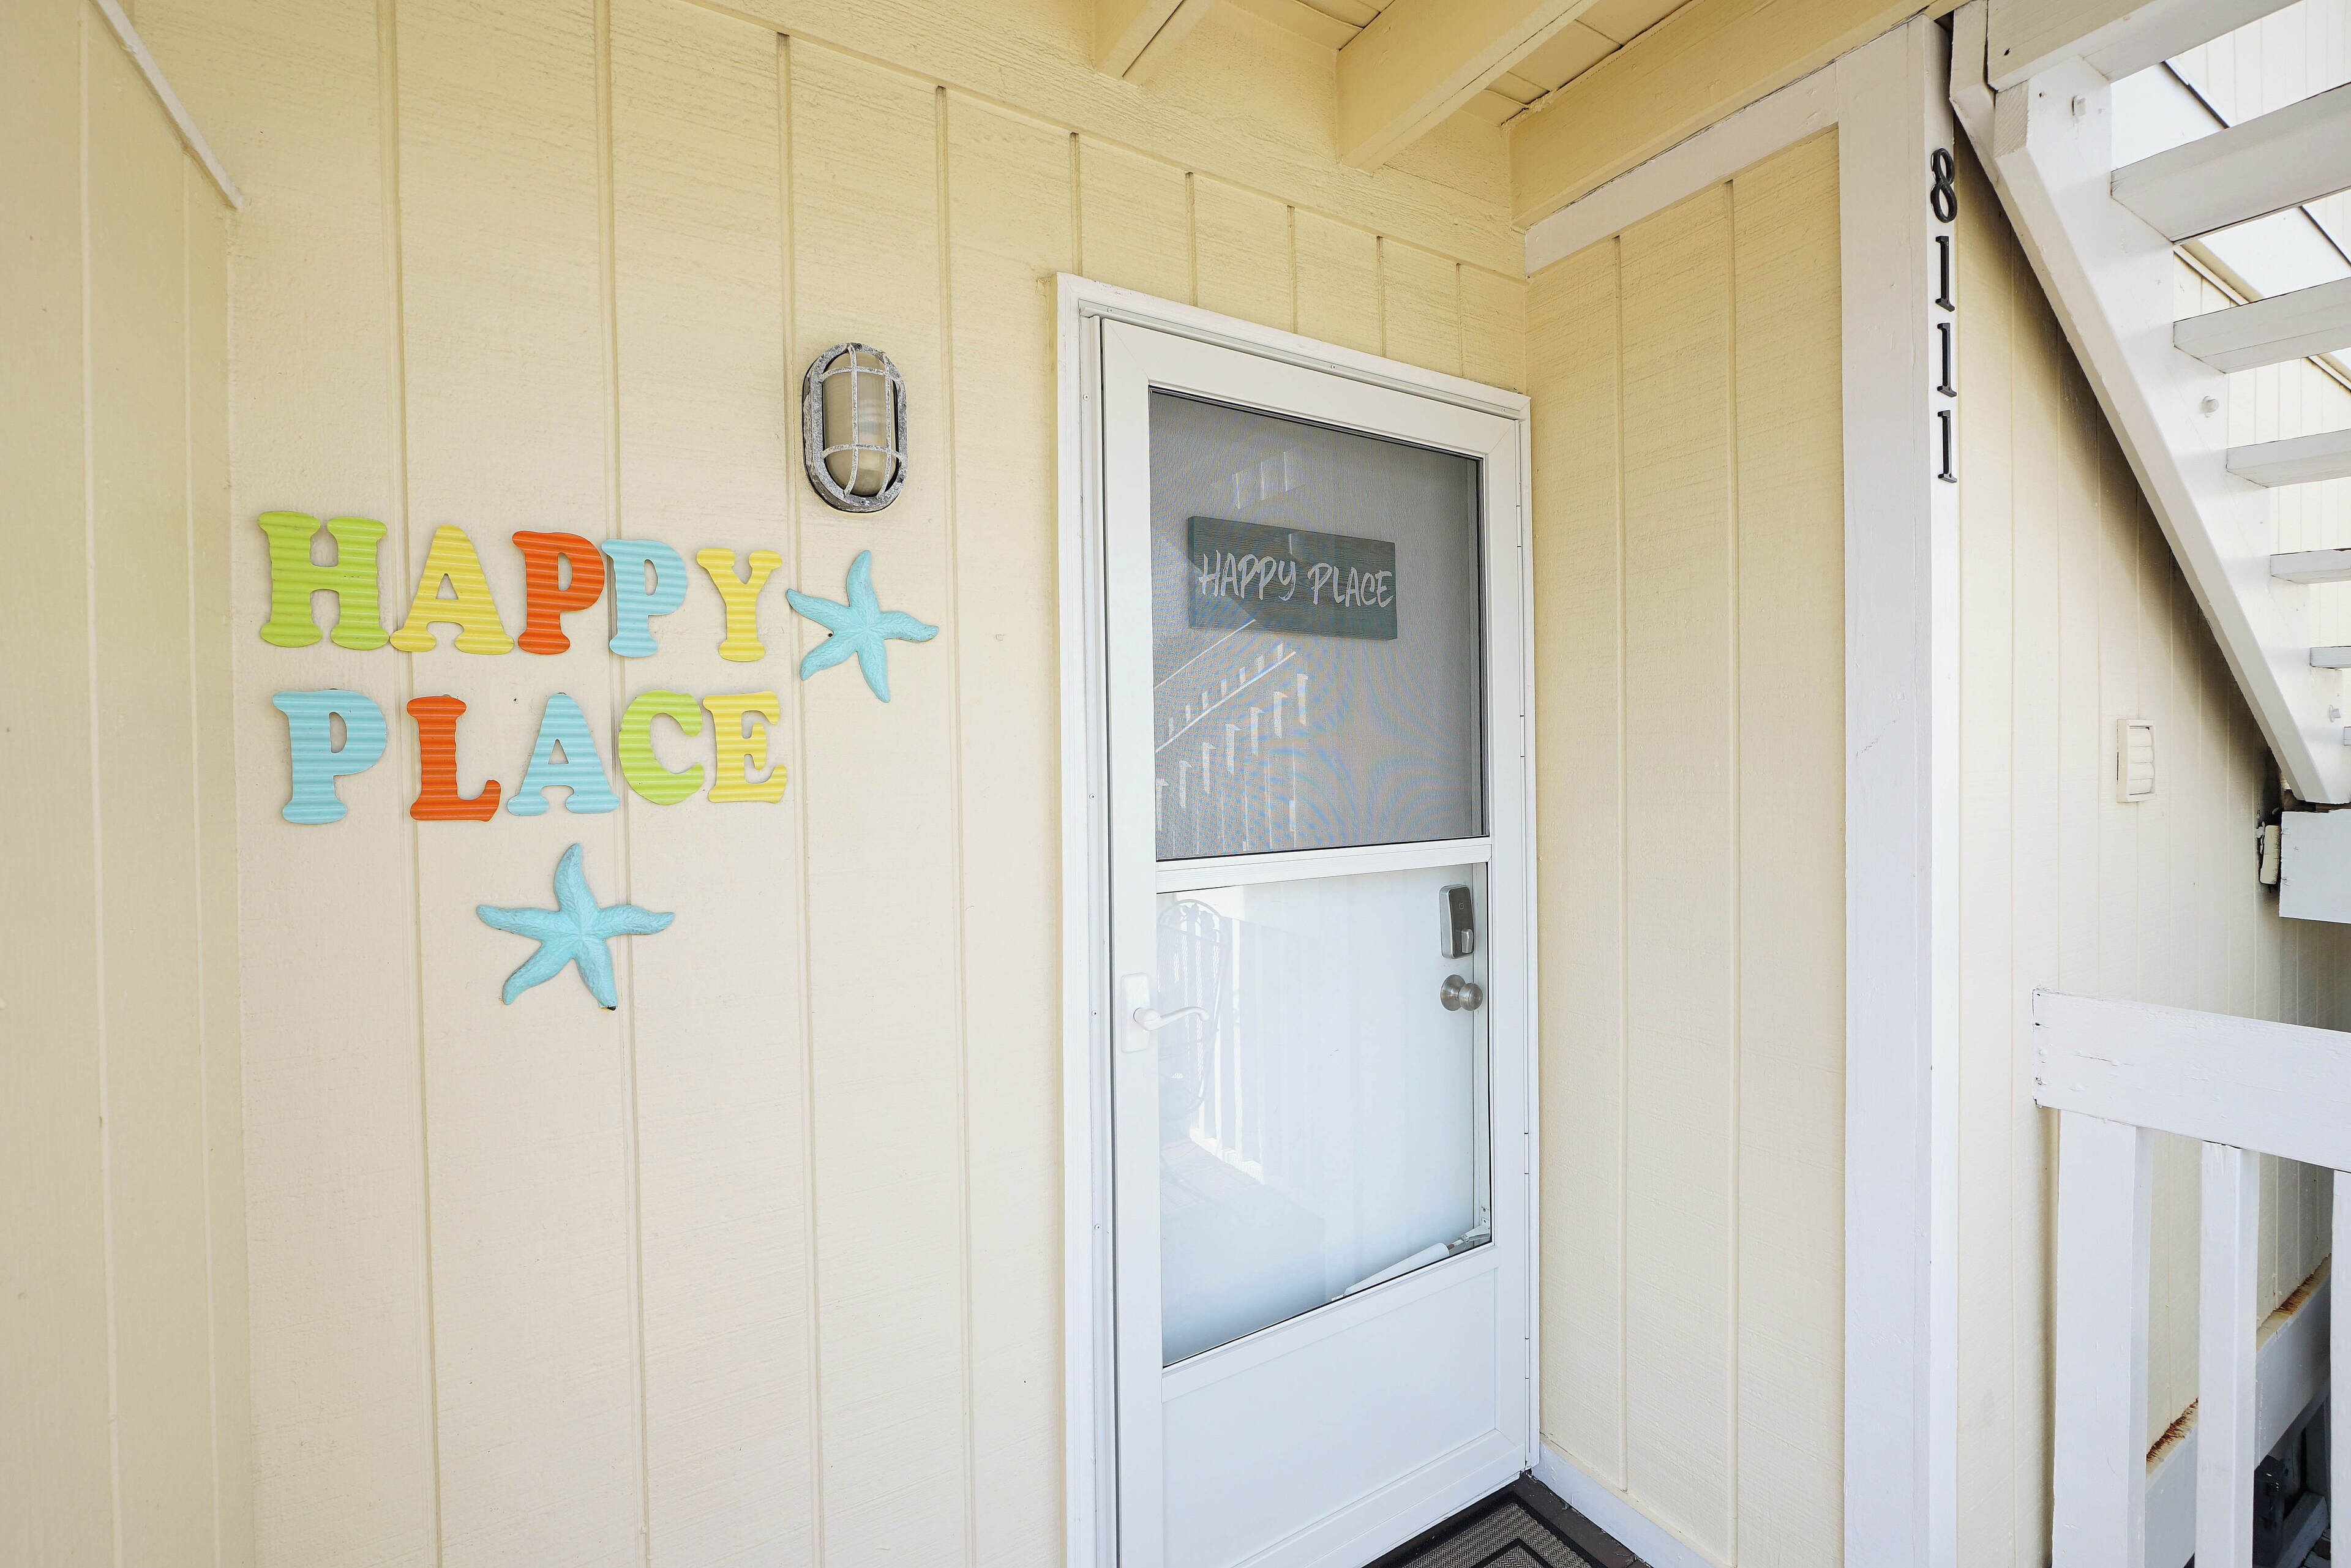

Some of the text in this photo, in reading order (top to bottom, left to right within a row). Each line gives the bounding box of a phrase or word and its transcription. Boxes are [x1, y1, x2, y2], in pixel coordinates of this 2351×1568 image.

[1930, 148, 1957, 484] 8111
[257, 511, 782, 662] HAPPY
[1198, 549, 1393, 608] HAPPY PLACE
[272, 689, 787, 825] PLACE
